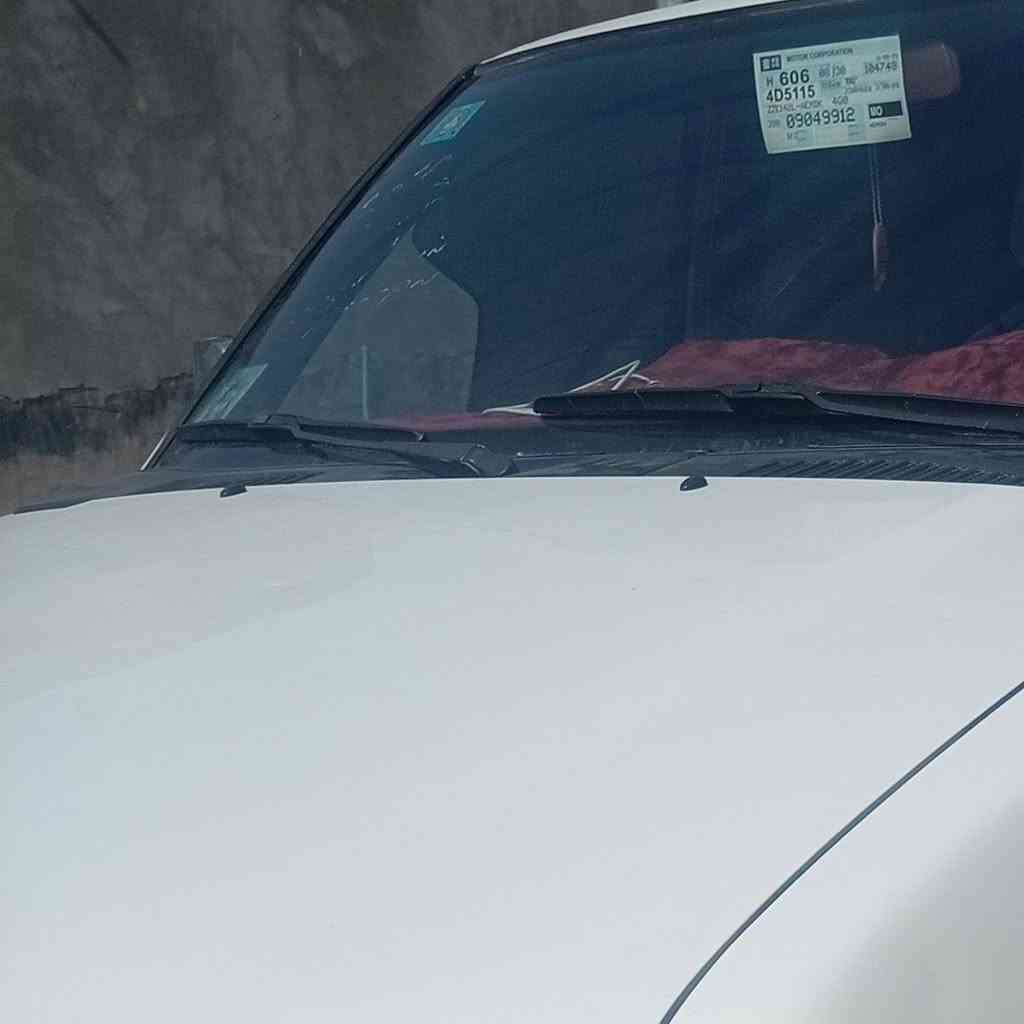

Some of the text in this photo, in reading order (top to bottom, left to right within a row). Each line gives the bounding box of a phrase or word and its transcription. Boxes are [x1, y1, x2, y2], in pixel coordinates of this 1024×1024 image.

[779, 69, 810, 86] 606
[766, 85, 816, 102] 4D5115
[786, 107, 856, 129] 09049912
